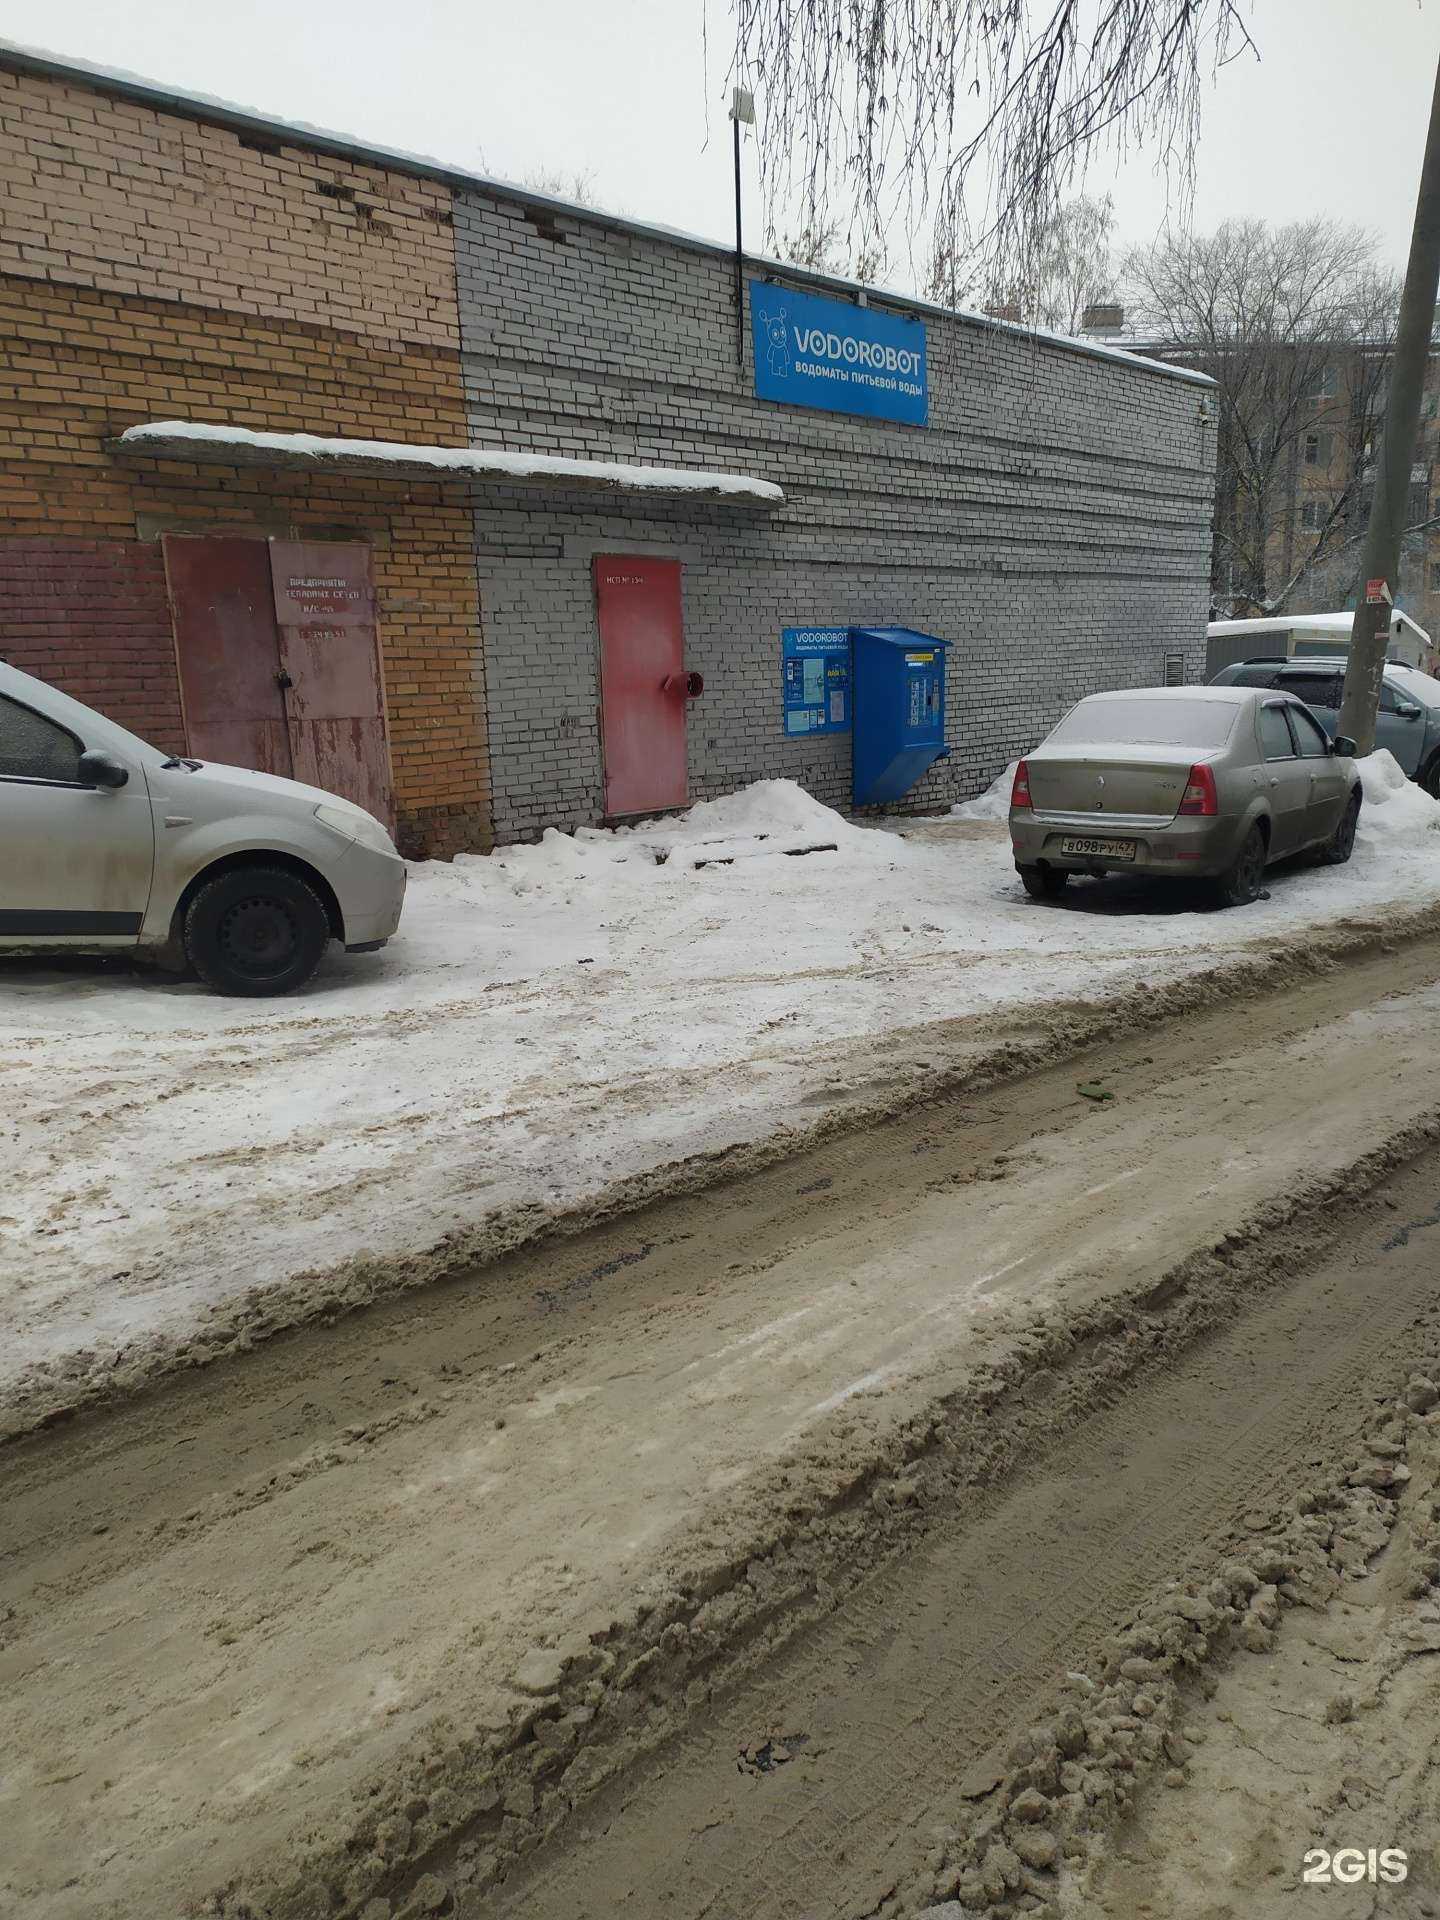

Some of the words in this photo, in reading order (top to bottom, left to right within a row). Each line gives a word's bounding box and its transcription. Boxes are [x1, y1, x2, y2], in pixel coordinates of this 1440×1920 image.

[793, 326, 921, 376] VODOROBOT
[795, 361, 849, 381] ВОДОМАТЫ
[851, 372, 897, 390] ПИТЬЕВОЙ
[898, 381, 922, 396] ВОДЫ
[795, 632, 848, 643] VODOROBOT
